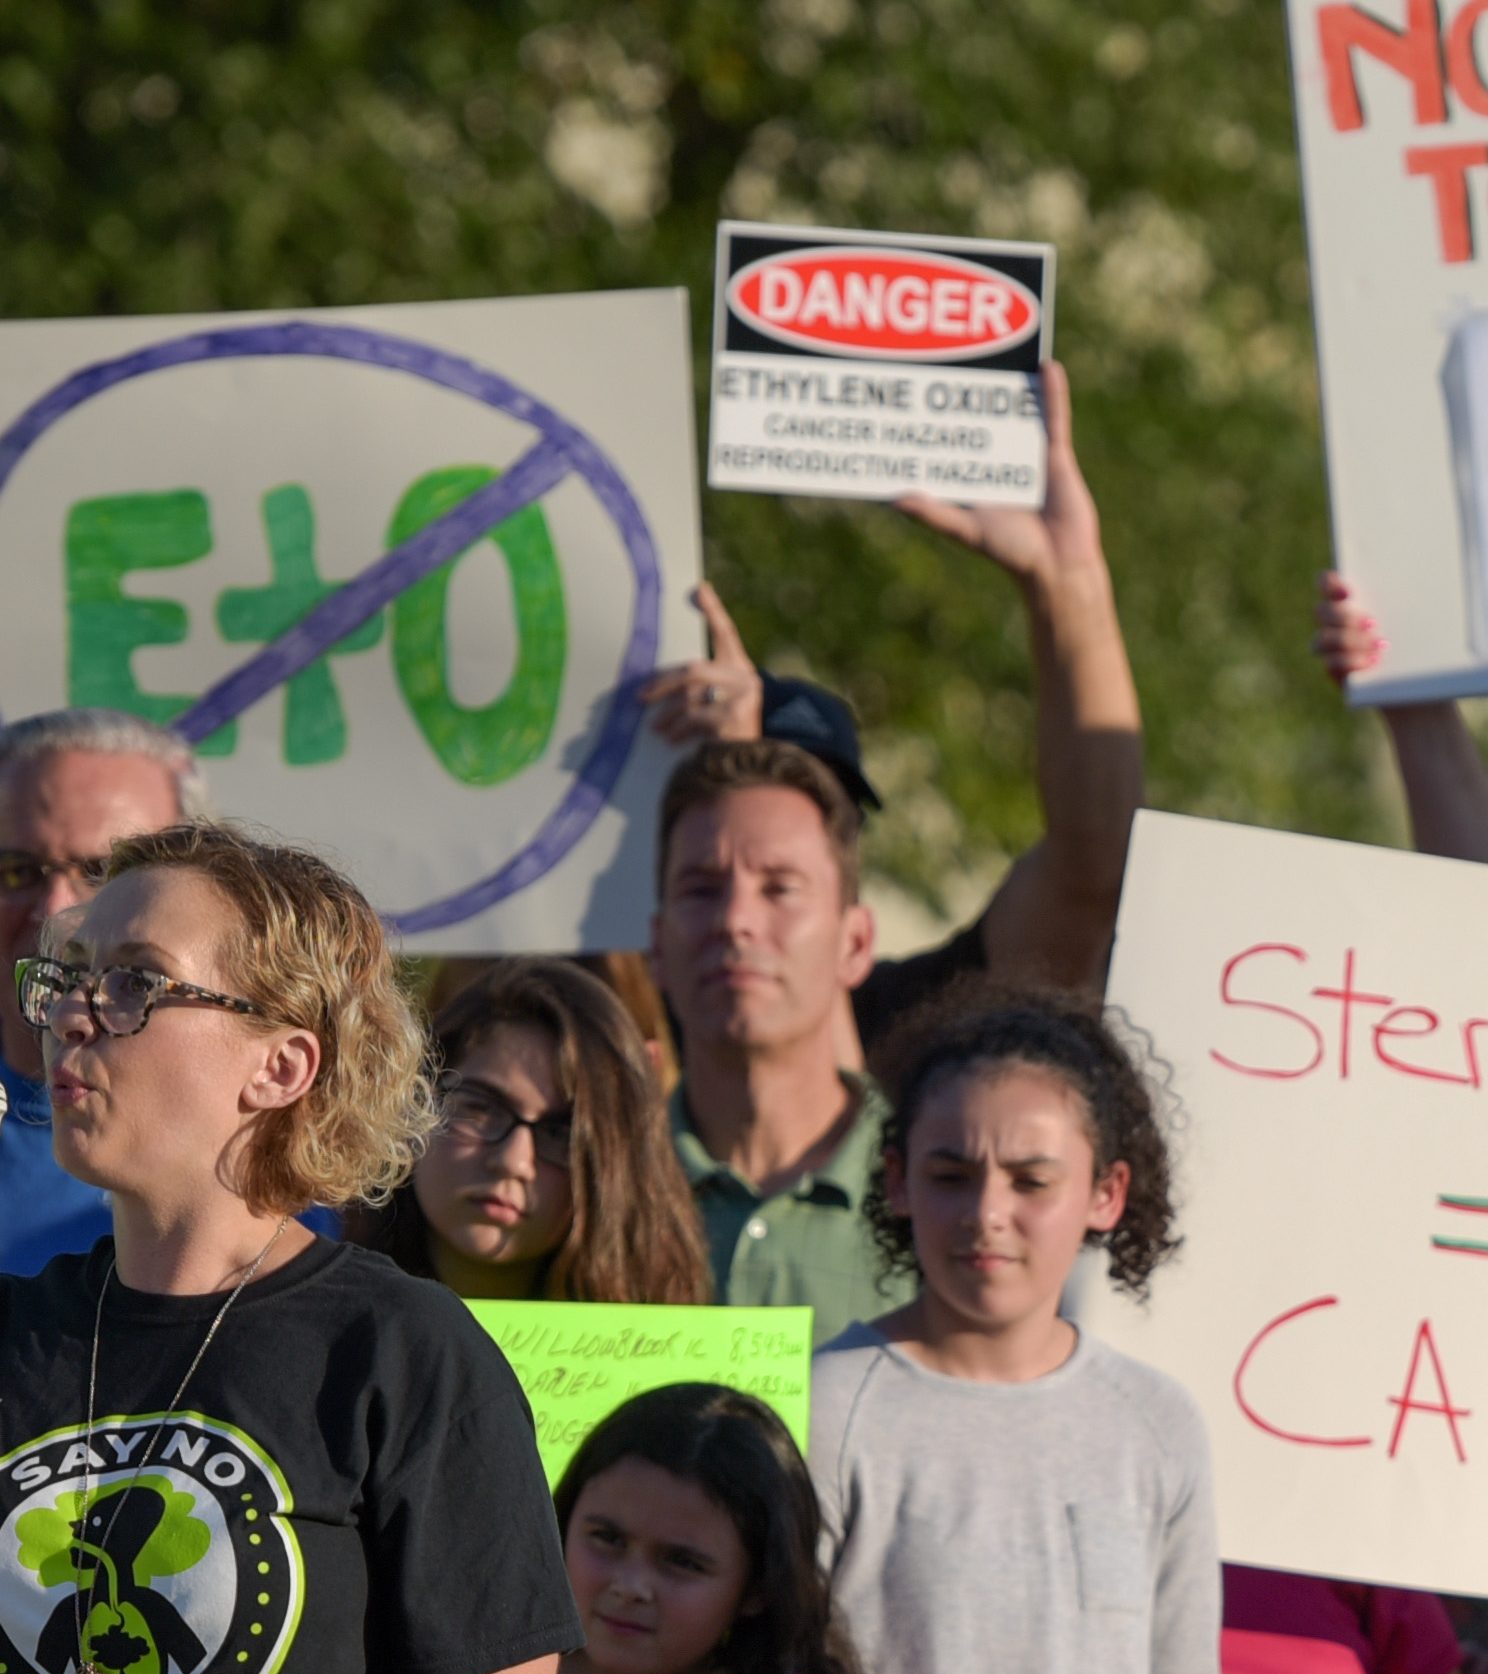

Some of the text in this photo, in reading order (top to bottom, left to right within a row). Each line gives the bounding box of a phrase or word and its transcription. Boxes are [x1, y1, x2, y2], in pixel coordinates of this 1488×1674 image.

[759, 267, 1013, 338] DANGER
[718, 367, 1040, 417] ETHYLENE OXIDE
[763, 413, 991, 450] CANCER HAZARD
[715, 445, 1035, 487] REPRODUCTIVE HAZARD
[11, 1429, 246, 1492] SAY NO
